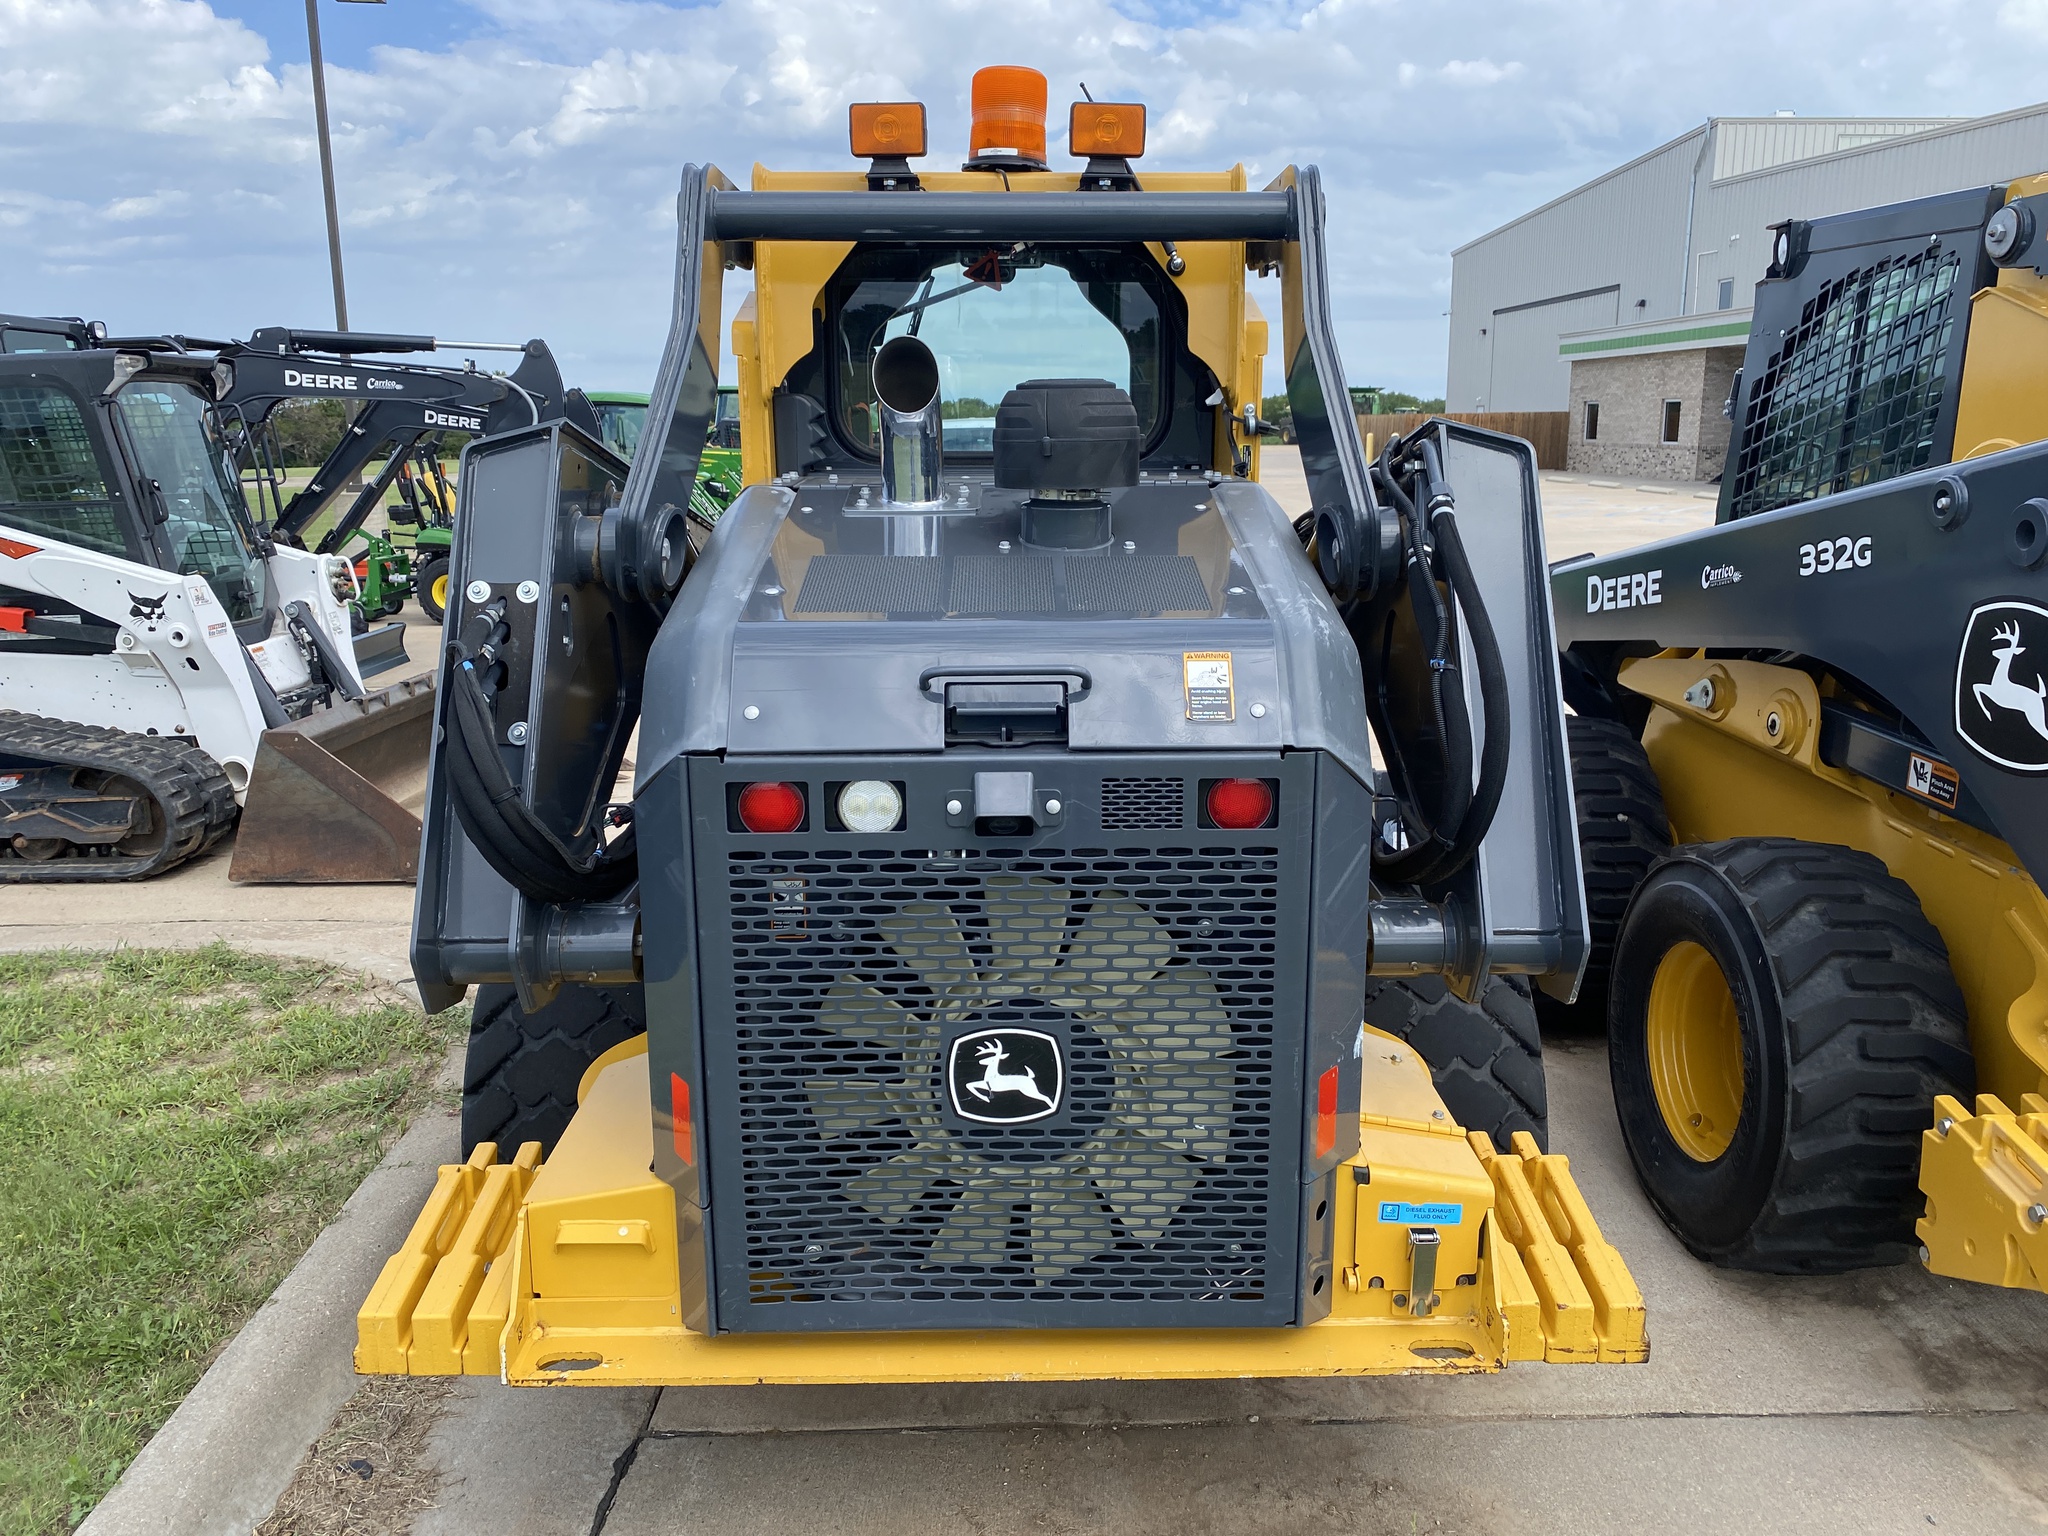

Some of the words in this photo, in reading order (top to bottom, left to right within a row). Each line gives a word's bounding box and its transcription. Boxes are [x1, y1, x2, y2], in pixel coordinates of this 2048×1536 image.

[284, 369, 358, 390] DEERE
[366, 377, 397, 390] Carrico
[424, 409, 481, 430] DEERE
[1799, 536, 1872, 576] 332G
[1701, 563, 1734, 590] Carrico
[1587, 569, 1663, 613] DEERE
[1931, 777, 1944, 788] Pinch
[1943, 783, 1955, 793] Area
[1939, 790, 1951, 800] Away
